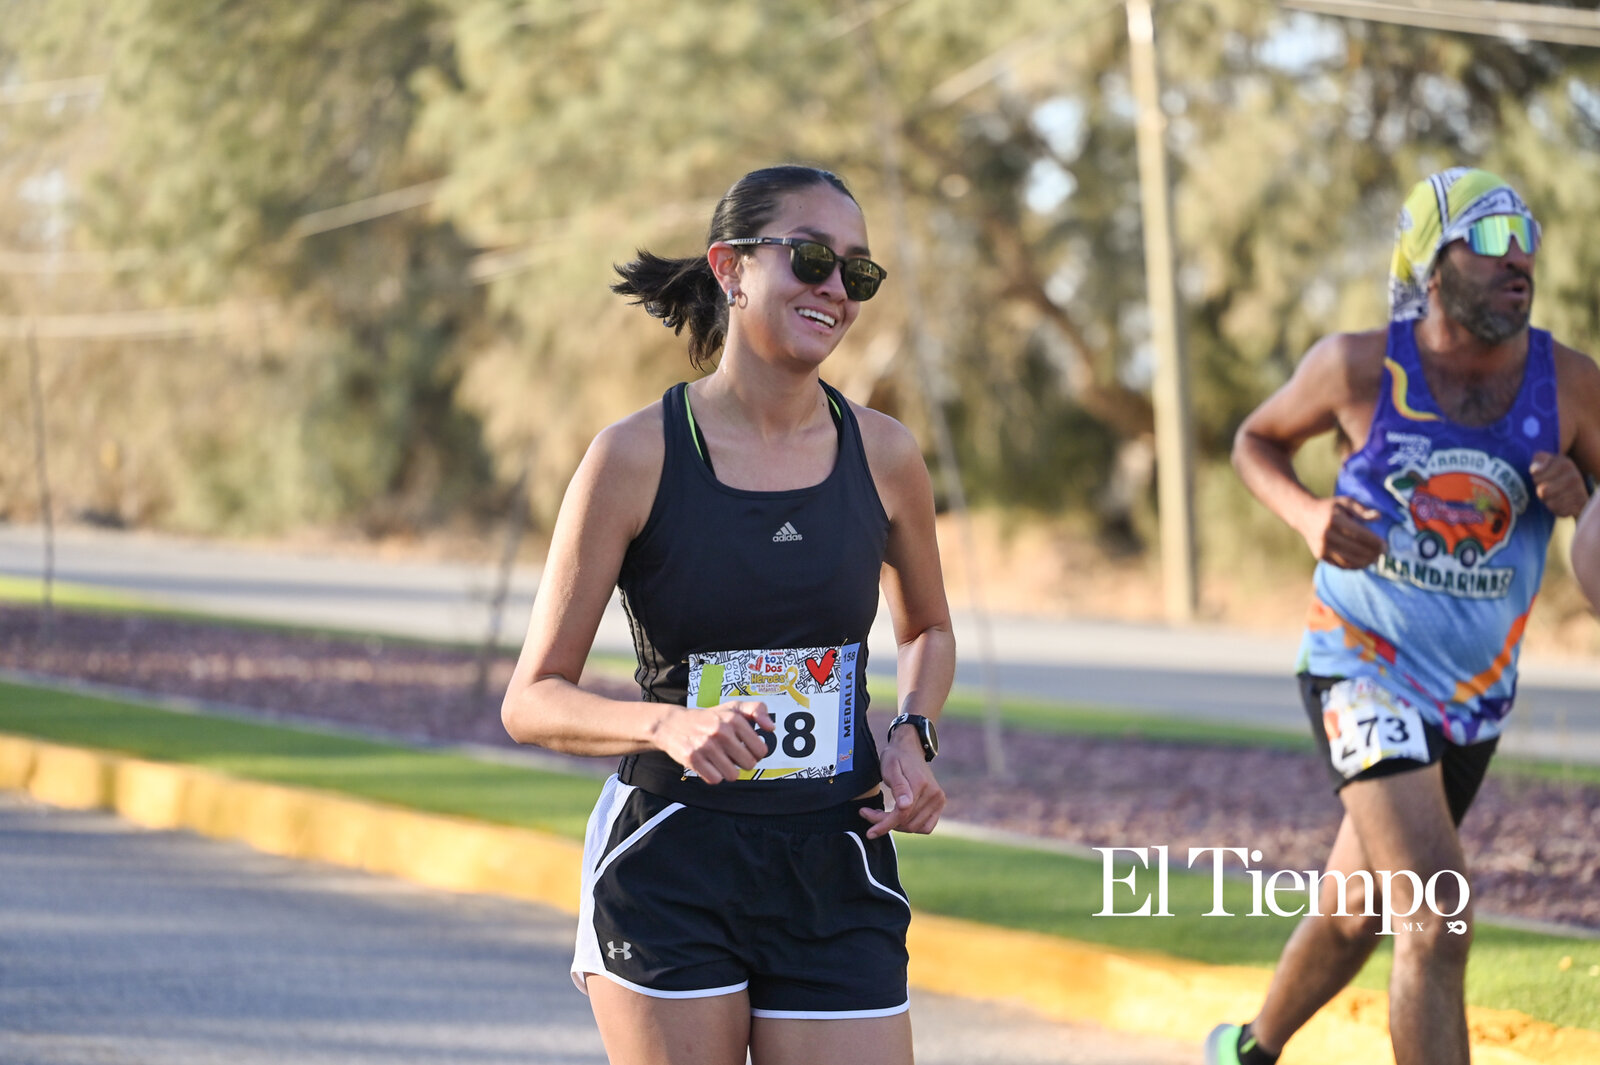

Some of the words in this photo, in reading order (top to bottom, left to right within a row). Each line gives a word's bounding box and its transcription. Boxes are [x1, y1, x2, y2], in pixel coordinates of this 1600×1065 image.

[772, 533, 803, 543] adidas
[843, 650, 856, 663] 158
[843, 670, 853, 738] MEDALLA
[747, 711, 816, 759] 58
